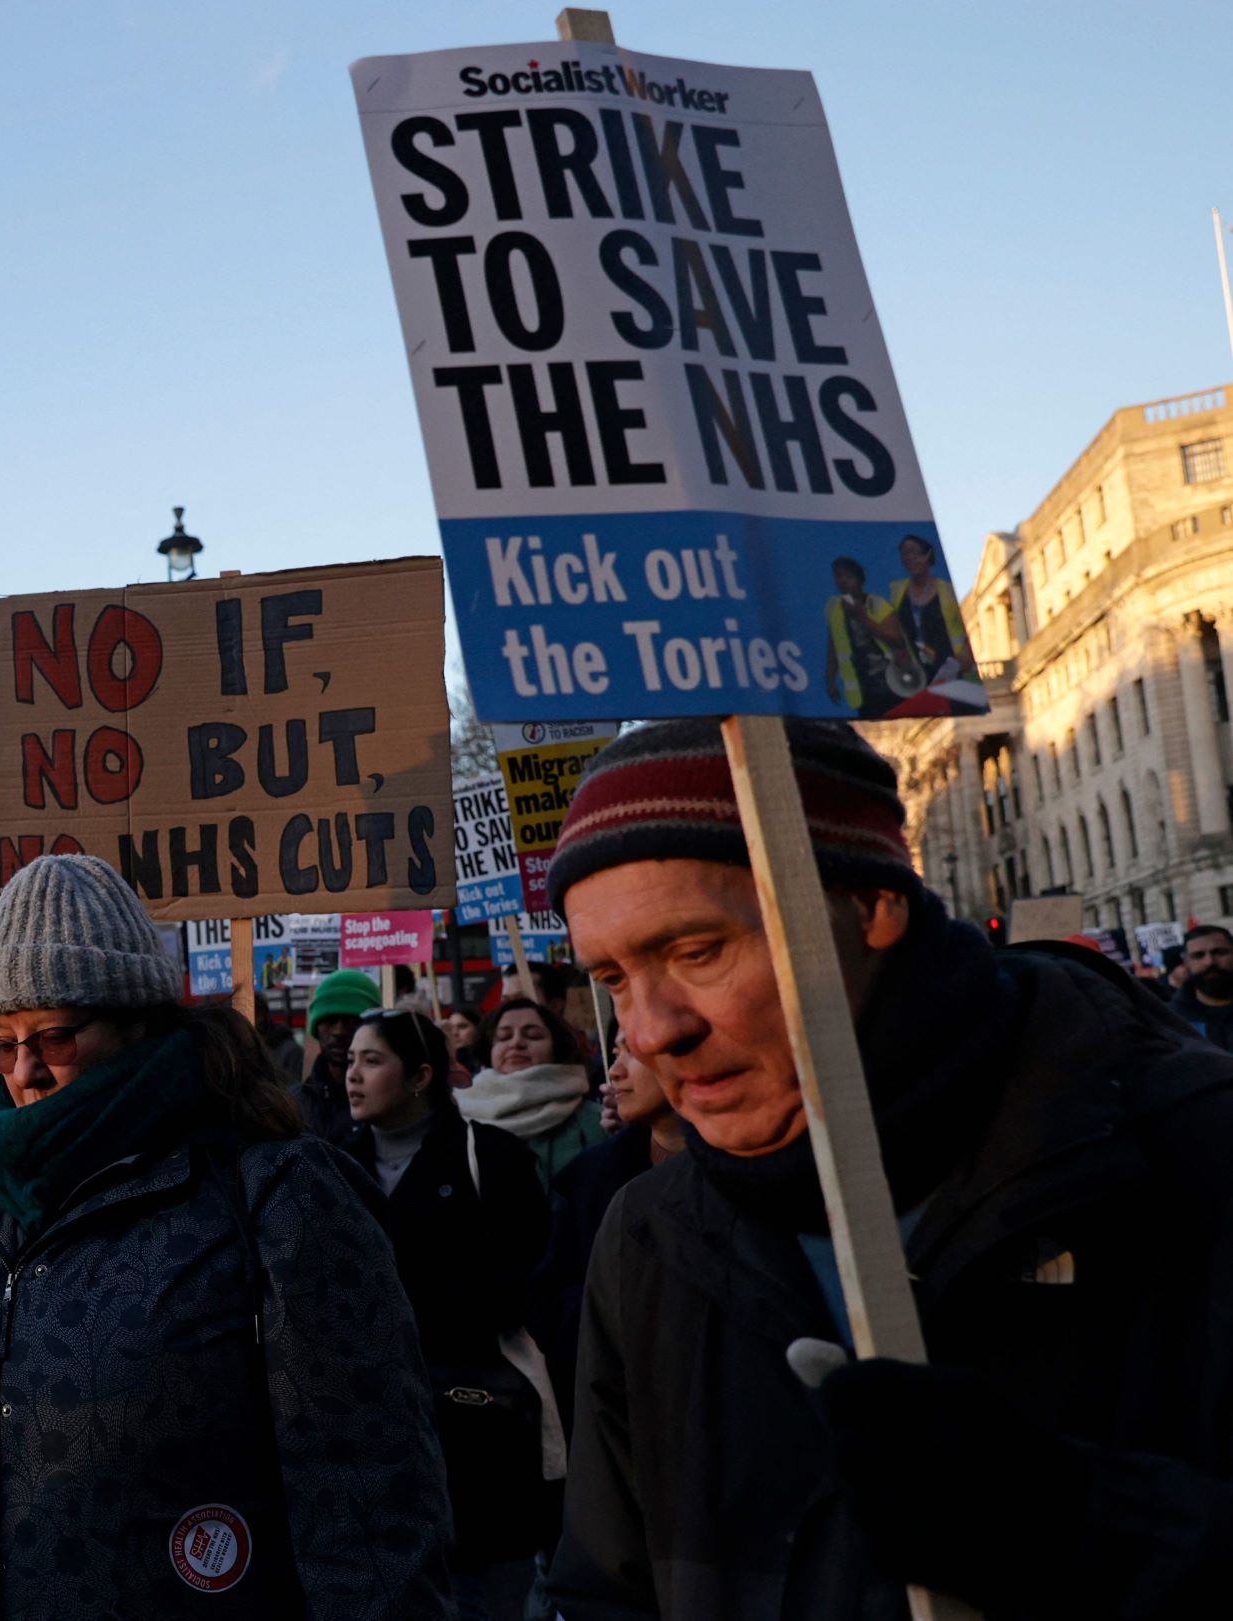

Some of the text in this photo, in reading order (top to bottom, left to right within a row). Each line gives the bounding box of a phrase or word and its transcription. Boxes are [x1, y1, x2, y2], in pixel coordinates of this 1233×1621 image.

[459, 61, 729, 114] Socialist Worker
[390, 107, 764, 238] STRIKE
[407, 229, 848, 365] TO SAVE
[432, 361, 896, 497] THE NHS
[484, 534, 746, 606] Kick out
[12, 589, 331, 712] NO IF,
[503, 619, 809, 696] the Tories
[21, 707, 385, 810] NO BUT,
[507, 747, 600, 786] Migra
[515, 781, 575, 816] mak
[118, 815, 259, 900] NHS
[279, 805, 437, 895] CUTS
[456, 815, 512, 851] O SAV
[456, 851, 488, 881] HE
[196, 914, 284, 944] THE HS
[345, 916, 391, 936] Stop the
[345, 929, 419, 950] scapegoating
